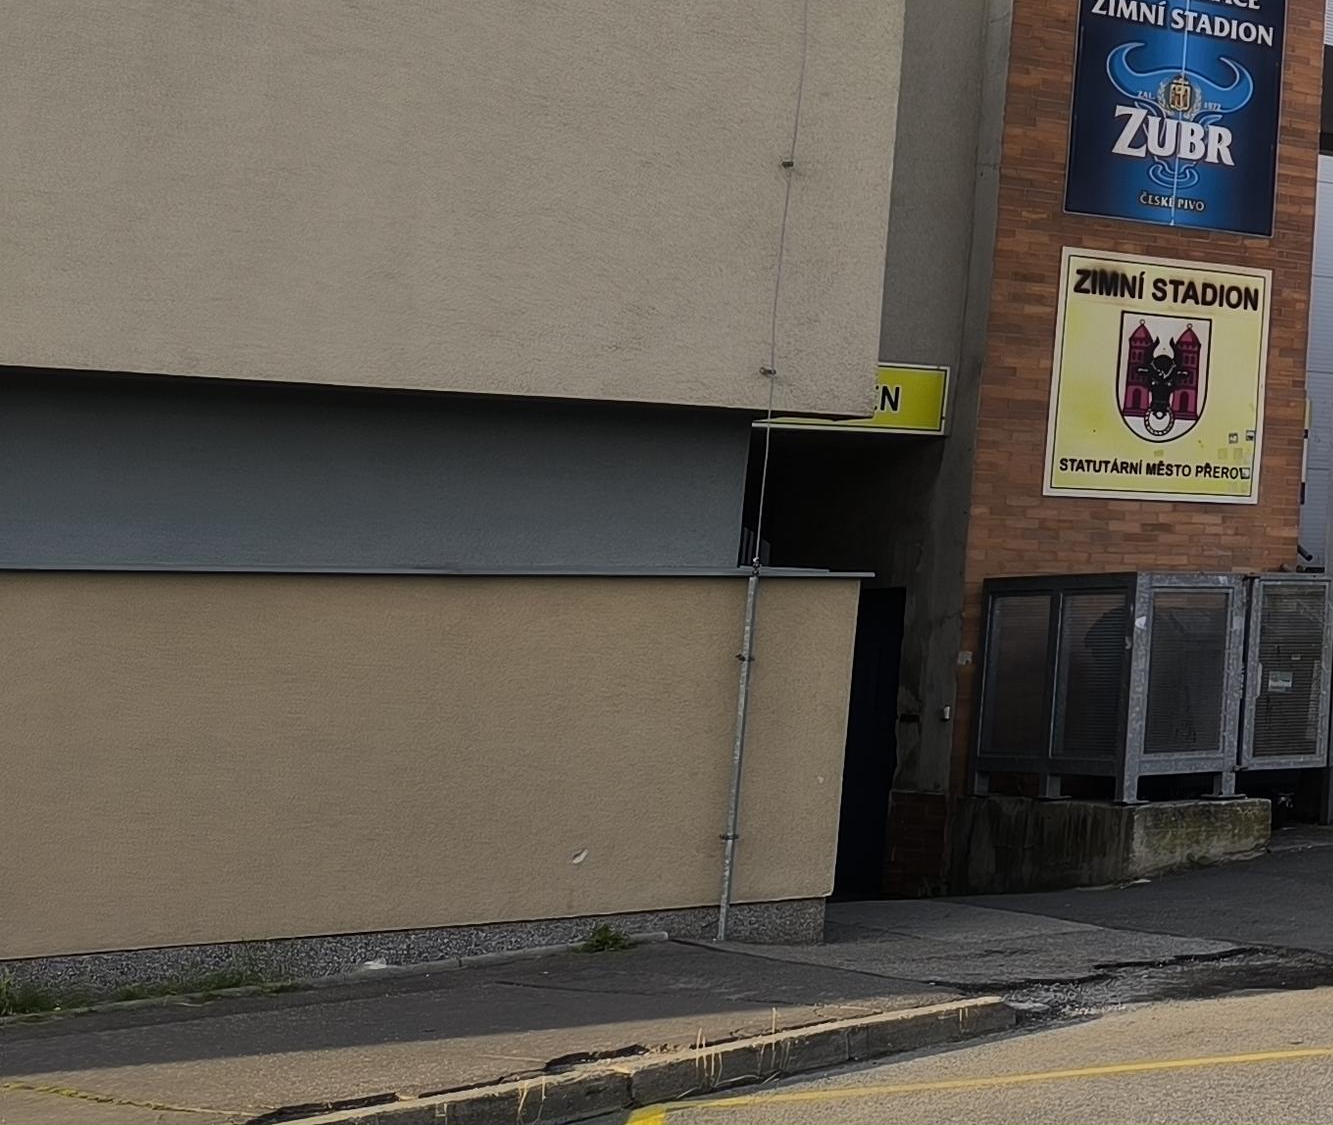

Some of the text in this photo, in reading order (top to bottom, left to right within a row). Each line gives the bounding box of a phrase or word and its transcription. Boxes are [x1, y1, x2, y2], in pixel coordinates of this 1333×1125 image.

[1170, 8, 1274, 47] STADION
[1111, 104, 1236, 166] ZUBR
[1176, 198, 1205, 212] PIVO
[1073, 268, 1259, 311] ZIMNÍ STADION
[874, 385, 900, 411] N
[1059, 458, 1143, 475] STATUTÁRNÍ
[1146, 459, 1192, 477] MĚSTO
